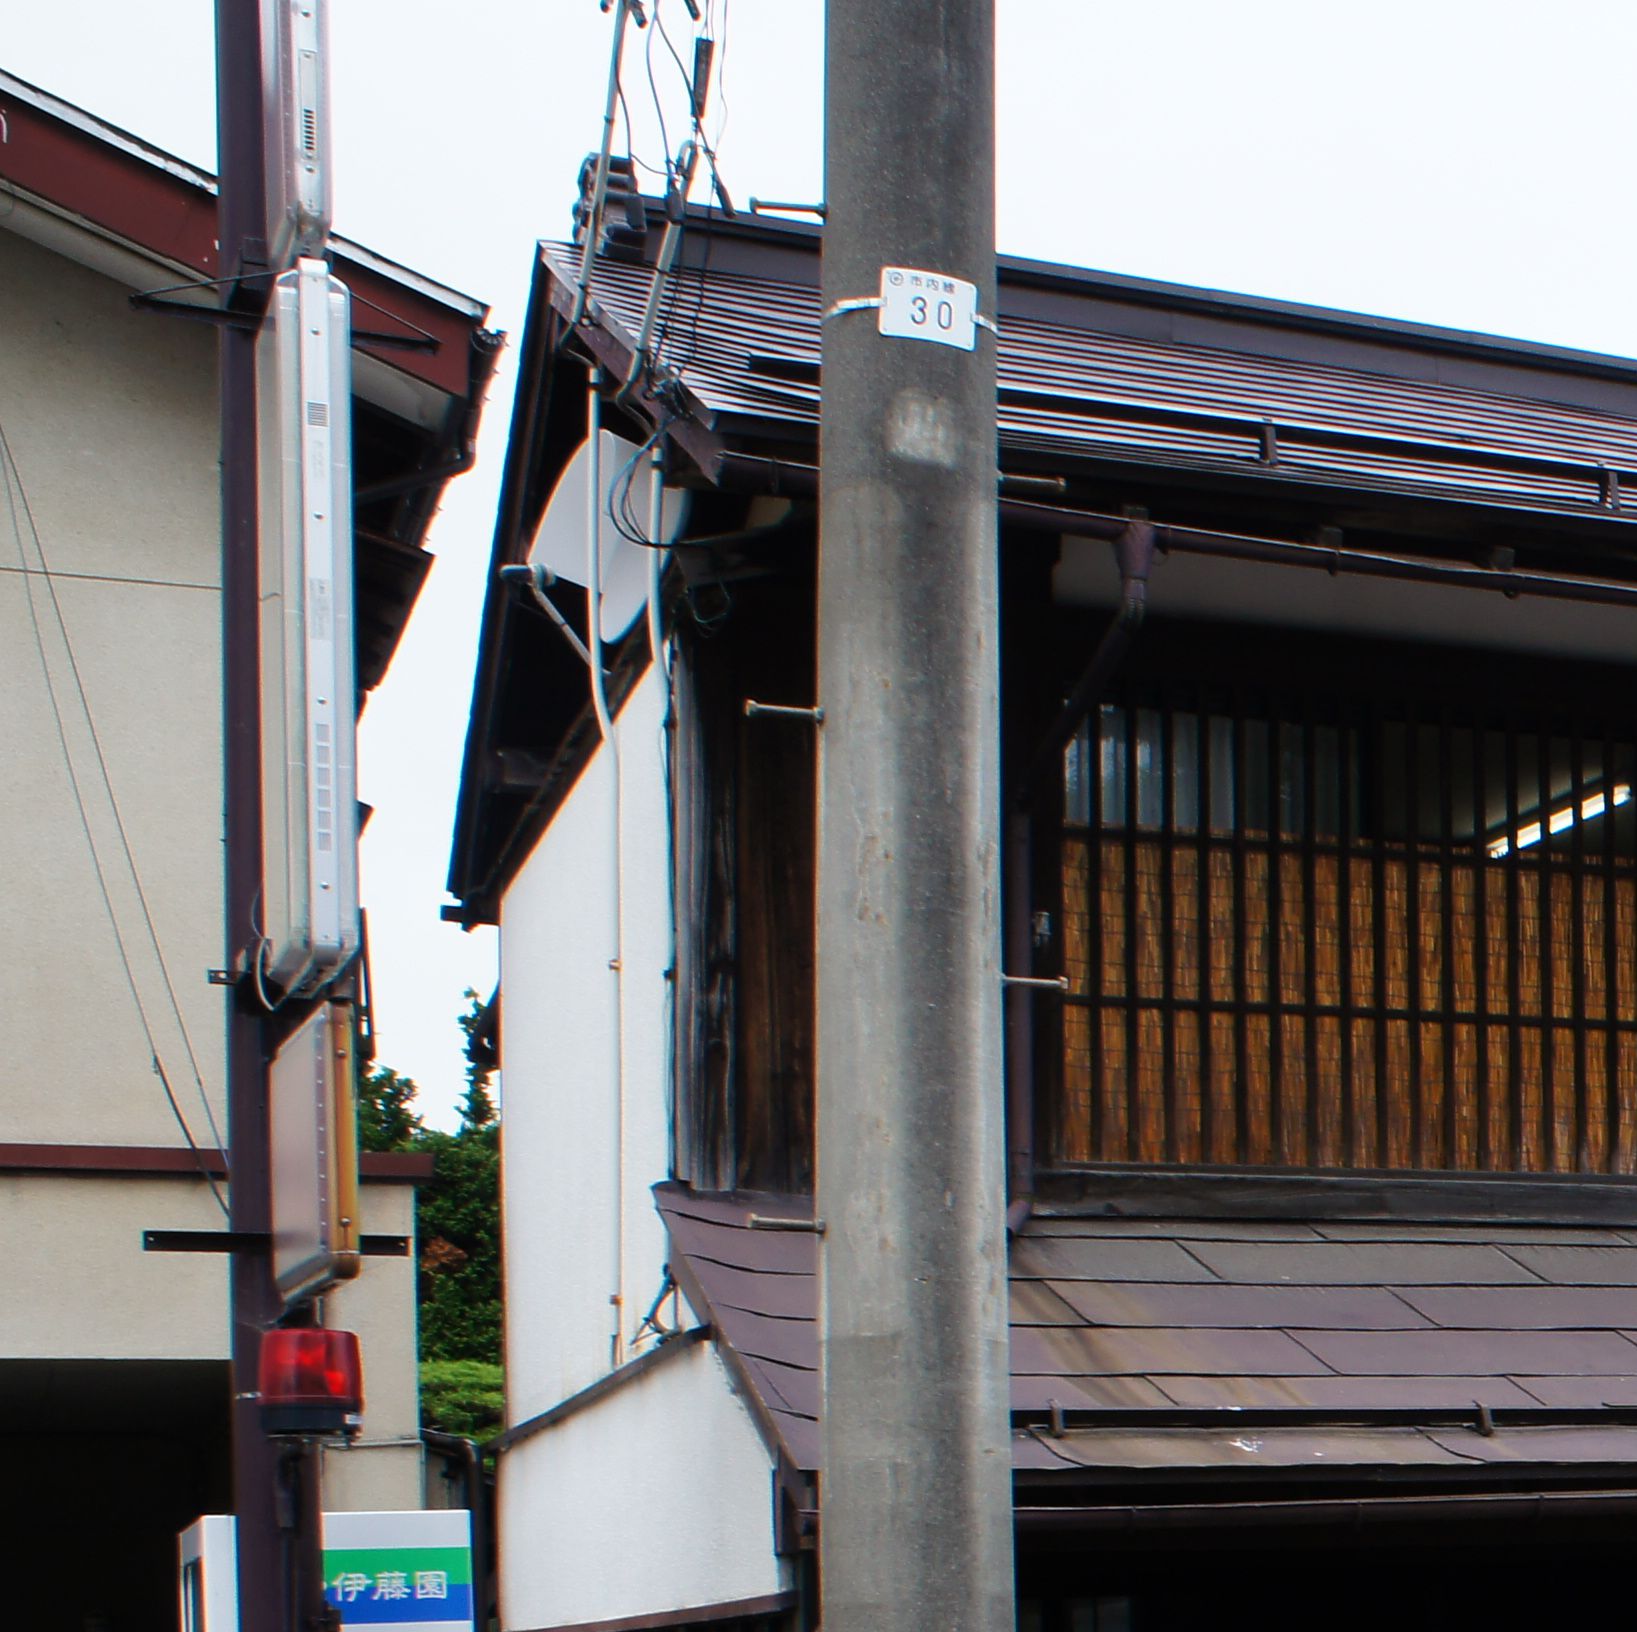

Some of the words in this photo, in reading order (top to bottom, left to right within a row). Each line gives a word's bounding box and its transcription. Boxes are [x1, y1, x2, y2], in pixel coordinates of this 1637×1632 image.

[911, 296, 952, 330] 30
[332, 1570, 448, 1602] 伊藤園
